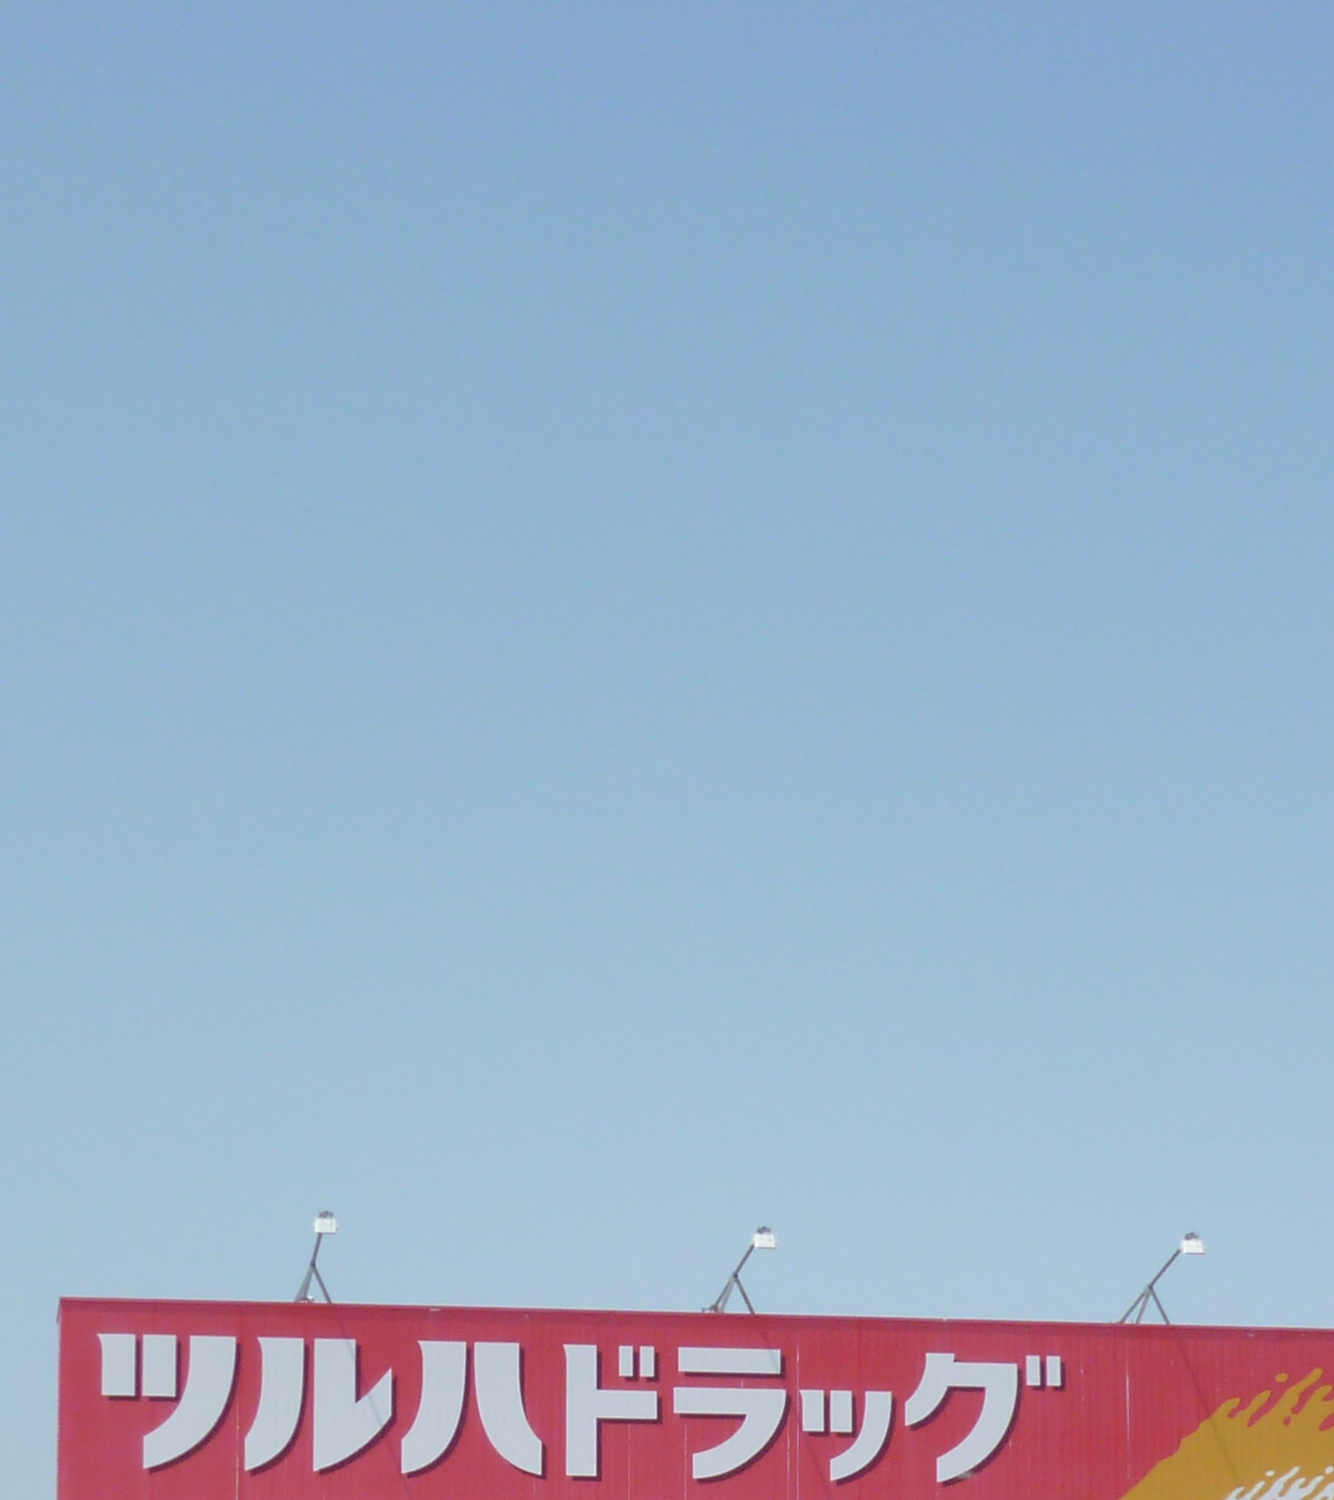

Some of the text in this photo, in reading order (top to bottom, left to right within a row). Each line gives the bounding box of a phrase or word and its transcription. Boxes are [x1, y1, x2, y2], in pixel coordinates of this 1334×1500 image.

[97, 1332, 1063, 1483] ツルハドラッグ
